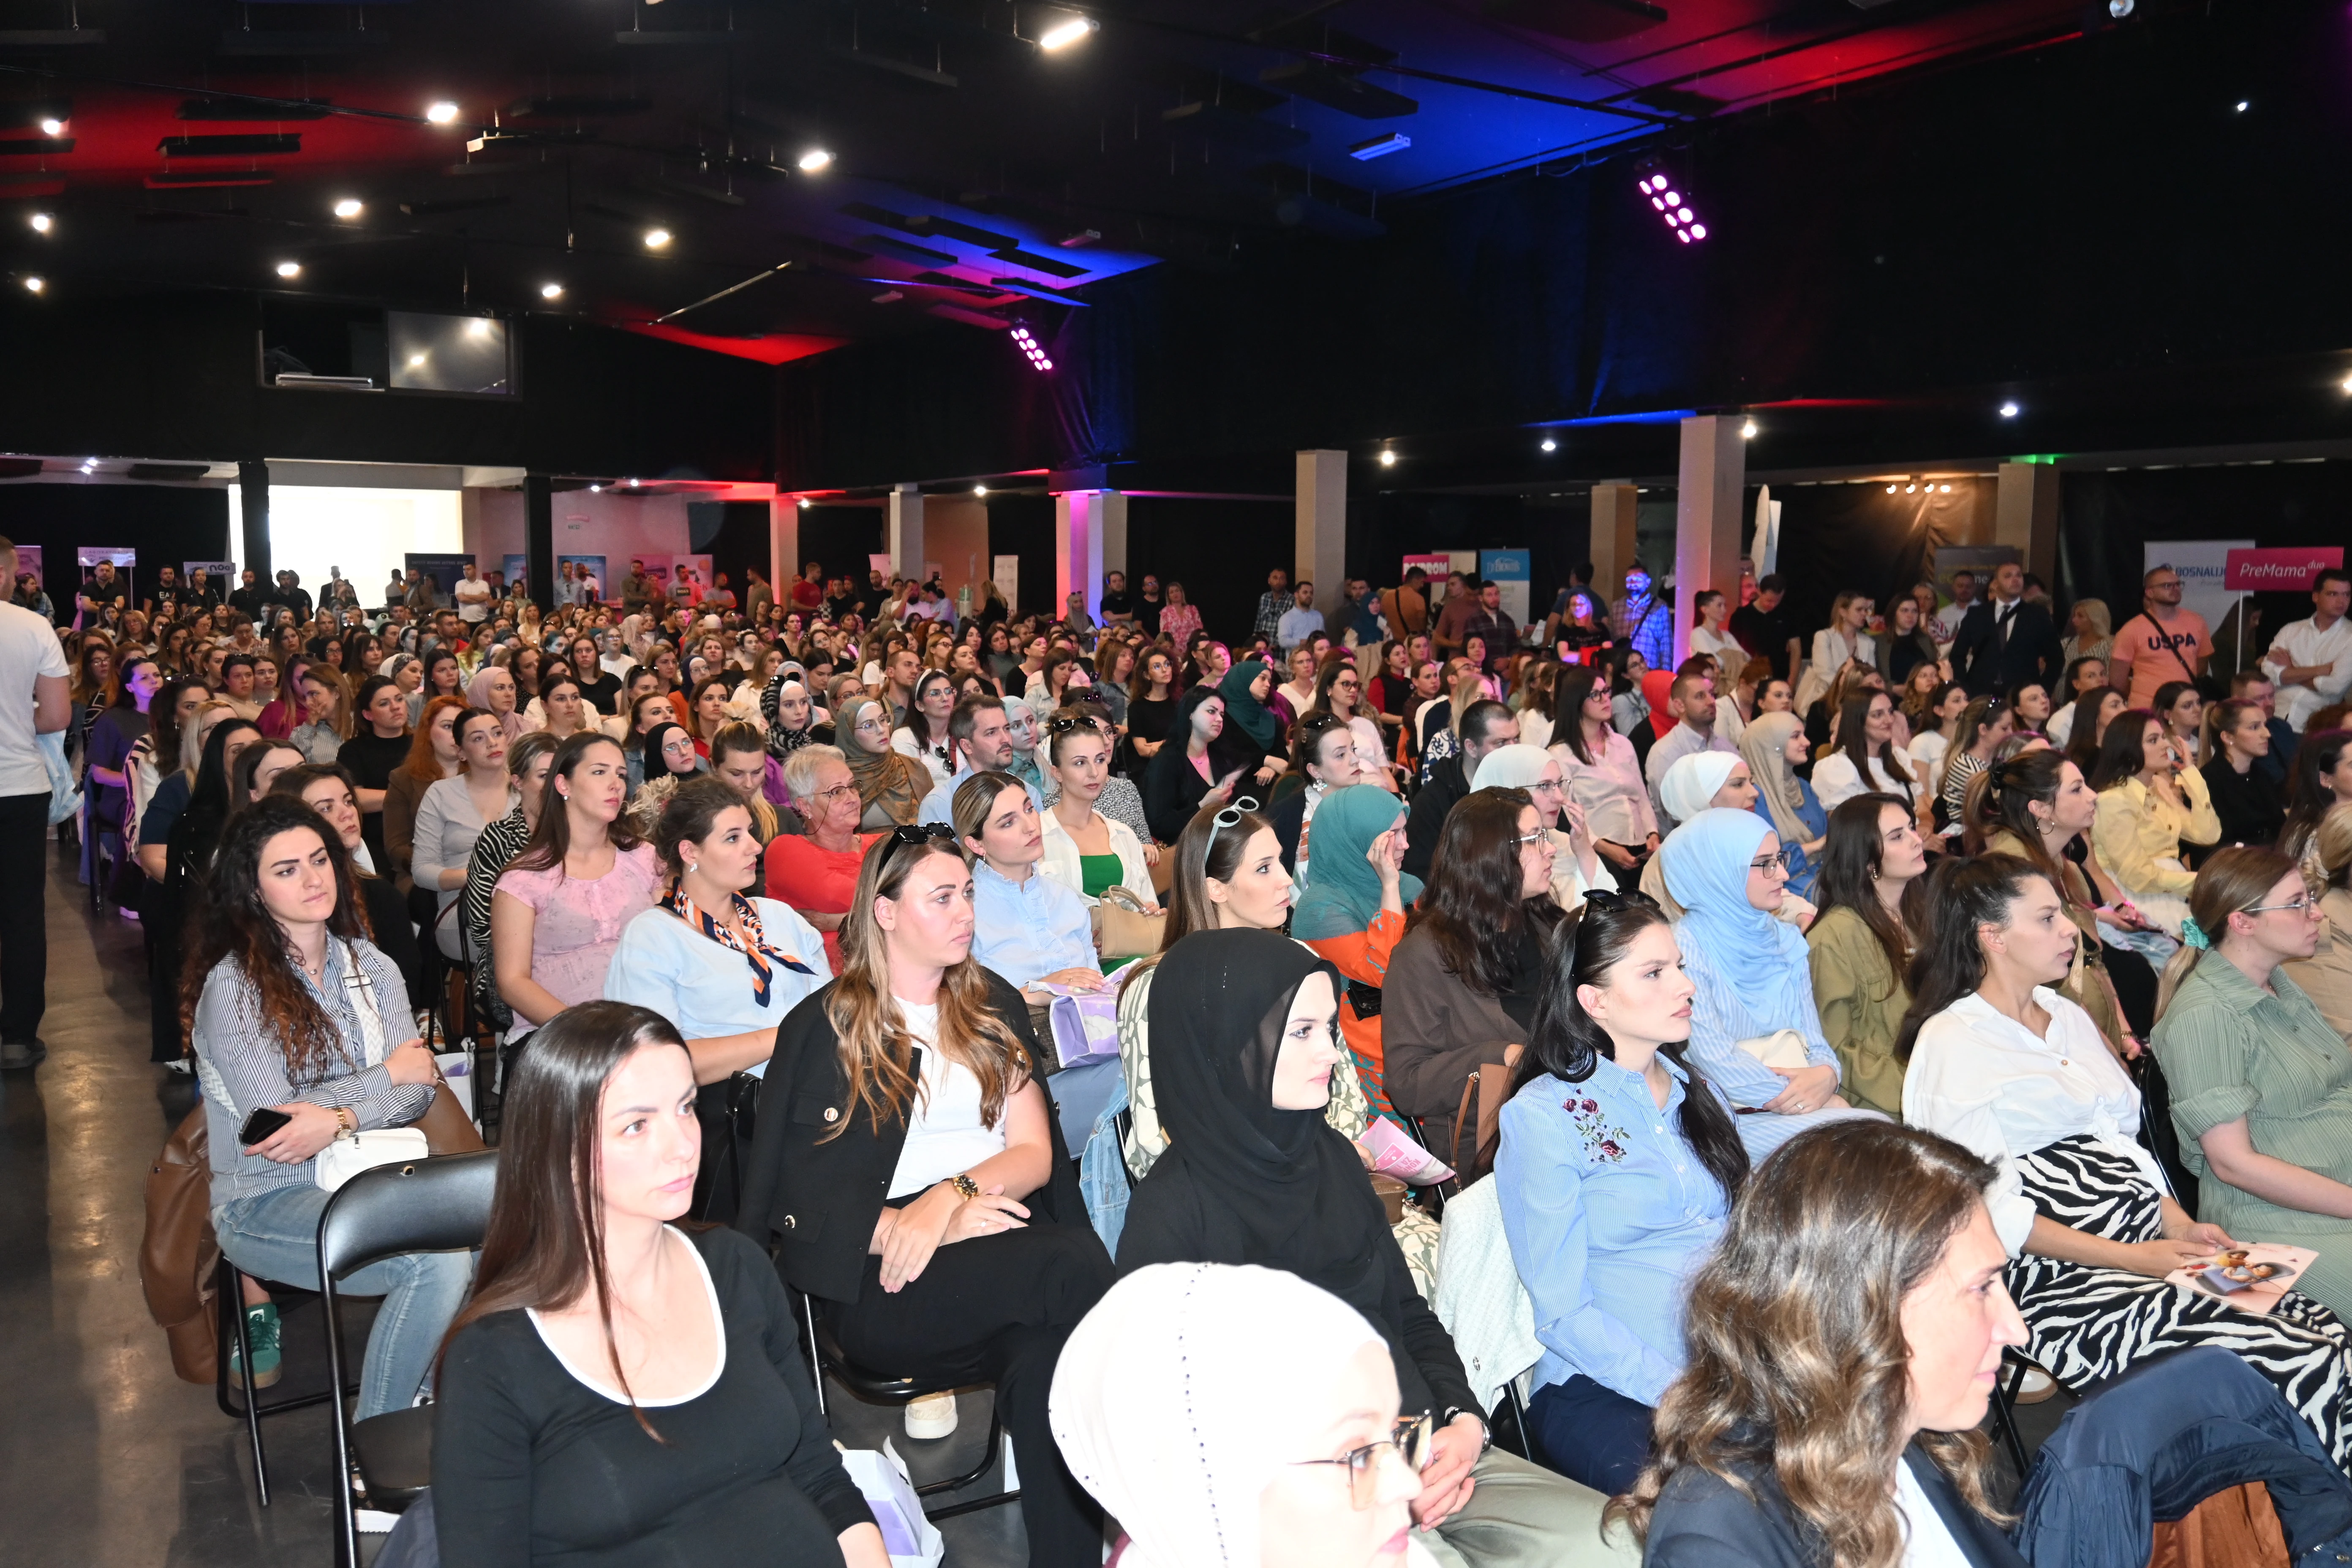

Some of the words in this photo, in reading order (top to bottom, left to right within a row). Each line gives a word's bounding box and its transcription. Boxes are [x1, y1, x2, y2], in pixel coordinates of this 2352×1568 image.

[2176, 566, 2226, 577] BOSNALIJ
[2240, 562, 2306, 577] PreMama
[1401, 1157, 1412, 1165] ZA
